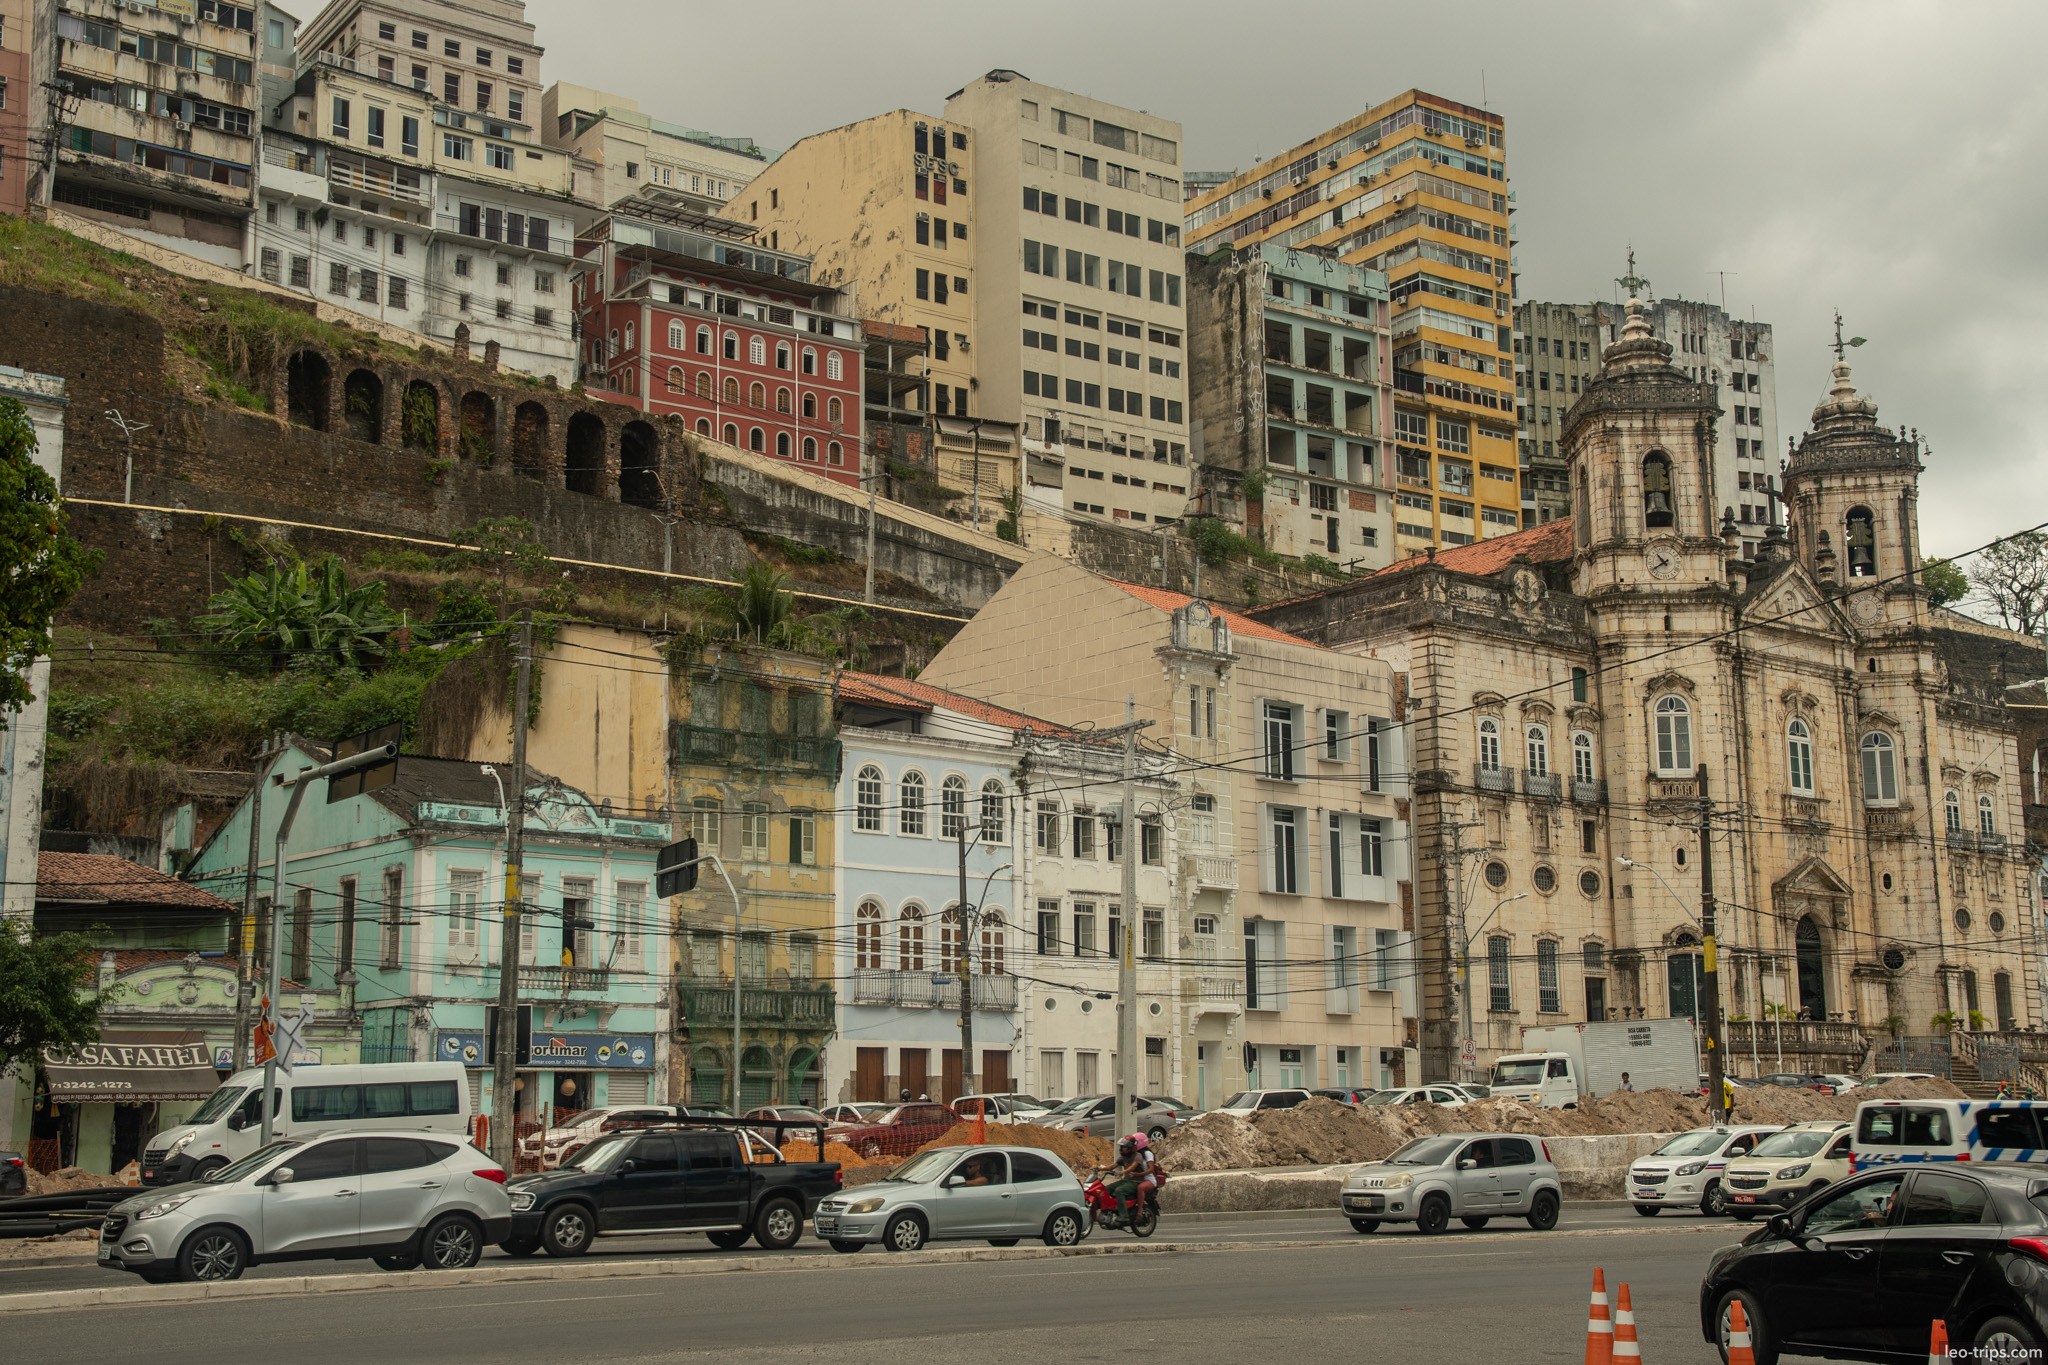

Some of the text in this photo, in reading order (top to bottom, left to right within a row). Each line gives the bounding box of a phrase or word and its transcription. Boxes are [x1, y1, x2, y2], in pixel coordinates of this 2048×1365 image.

[913, 152, 959, 176] SESC
[122, 1046, 209, 1066] FAHEL
[62, 1081, 132, 1089] 3242-1273
